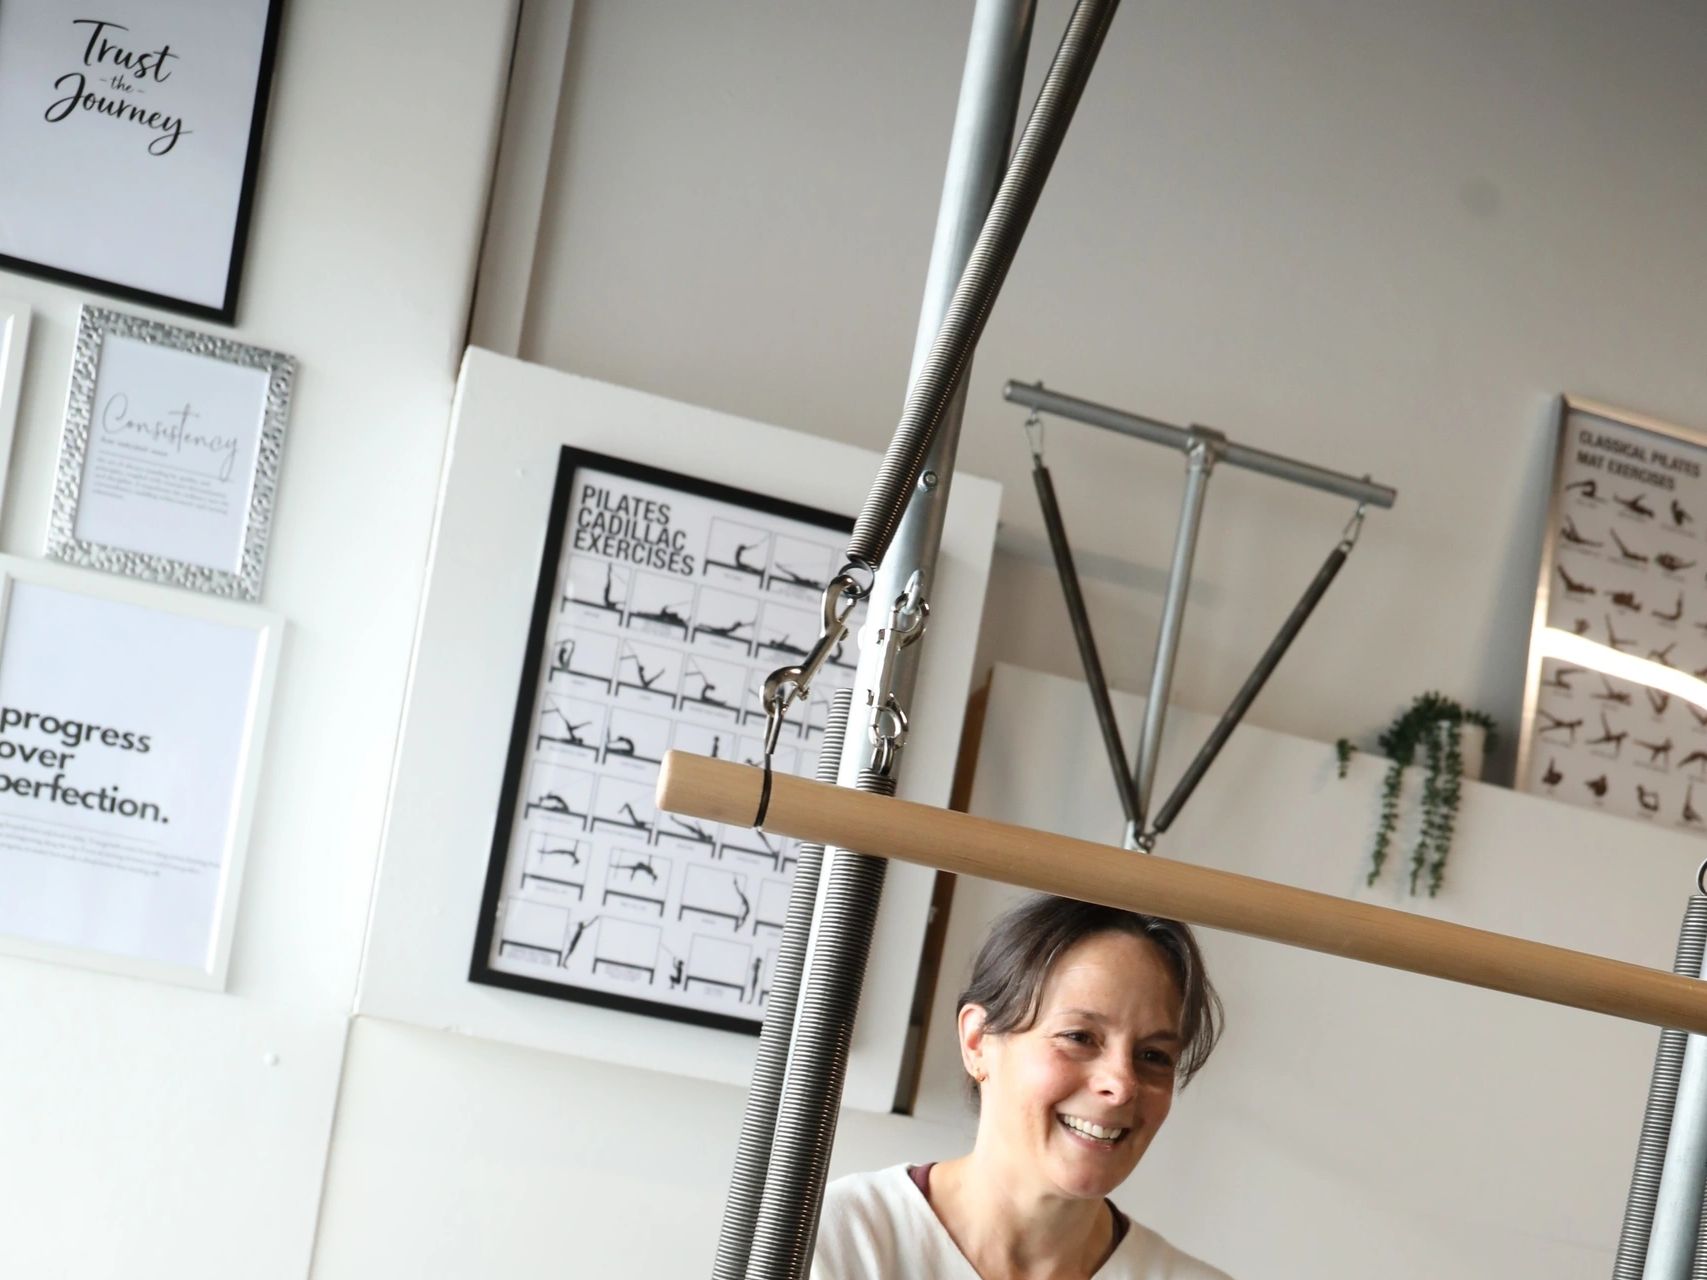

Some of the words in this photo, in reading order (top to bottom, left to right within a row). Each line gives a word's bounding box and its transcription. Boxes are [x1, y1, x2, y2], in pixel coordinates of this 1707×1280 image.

[73, 19, 180, 83] Trust
[110, 75, 134, 94] the
[44, 72, 193, 156] Journey
[102, 392, 238, 482] Consistency
[1578, 430, 1647, 463] CLASSICAL
[1650, 449, 1702, 478] PILATES
[1576, 449, 1605, 470] MAT
[1606, 457, 1675, 492] EXERCISES
[581, 484, 671, 526] PILATES
[573, 528, 695, 576] EXERCISES
[577, 506, 687, 552] CADILLAC
[0, 707, 152, 753] progress
[0, 740, 75, 769] over
